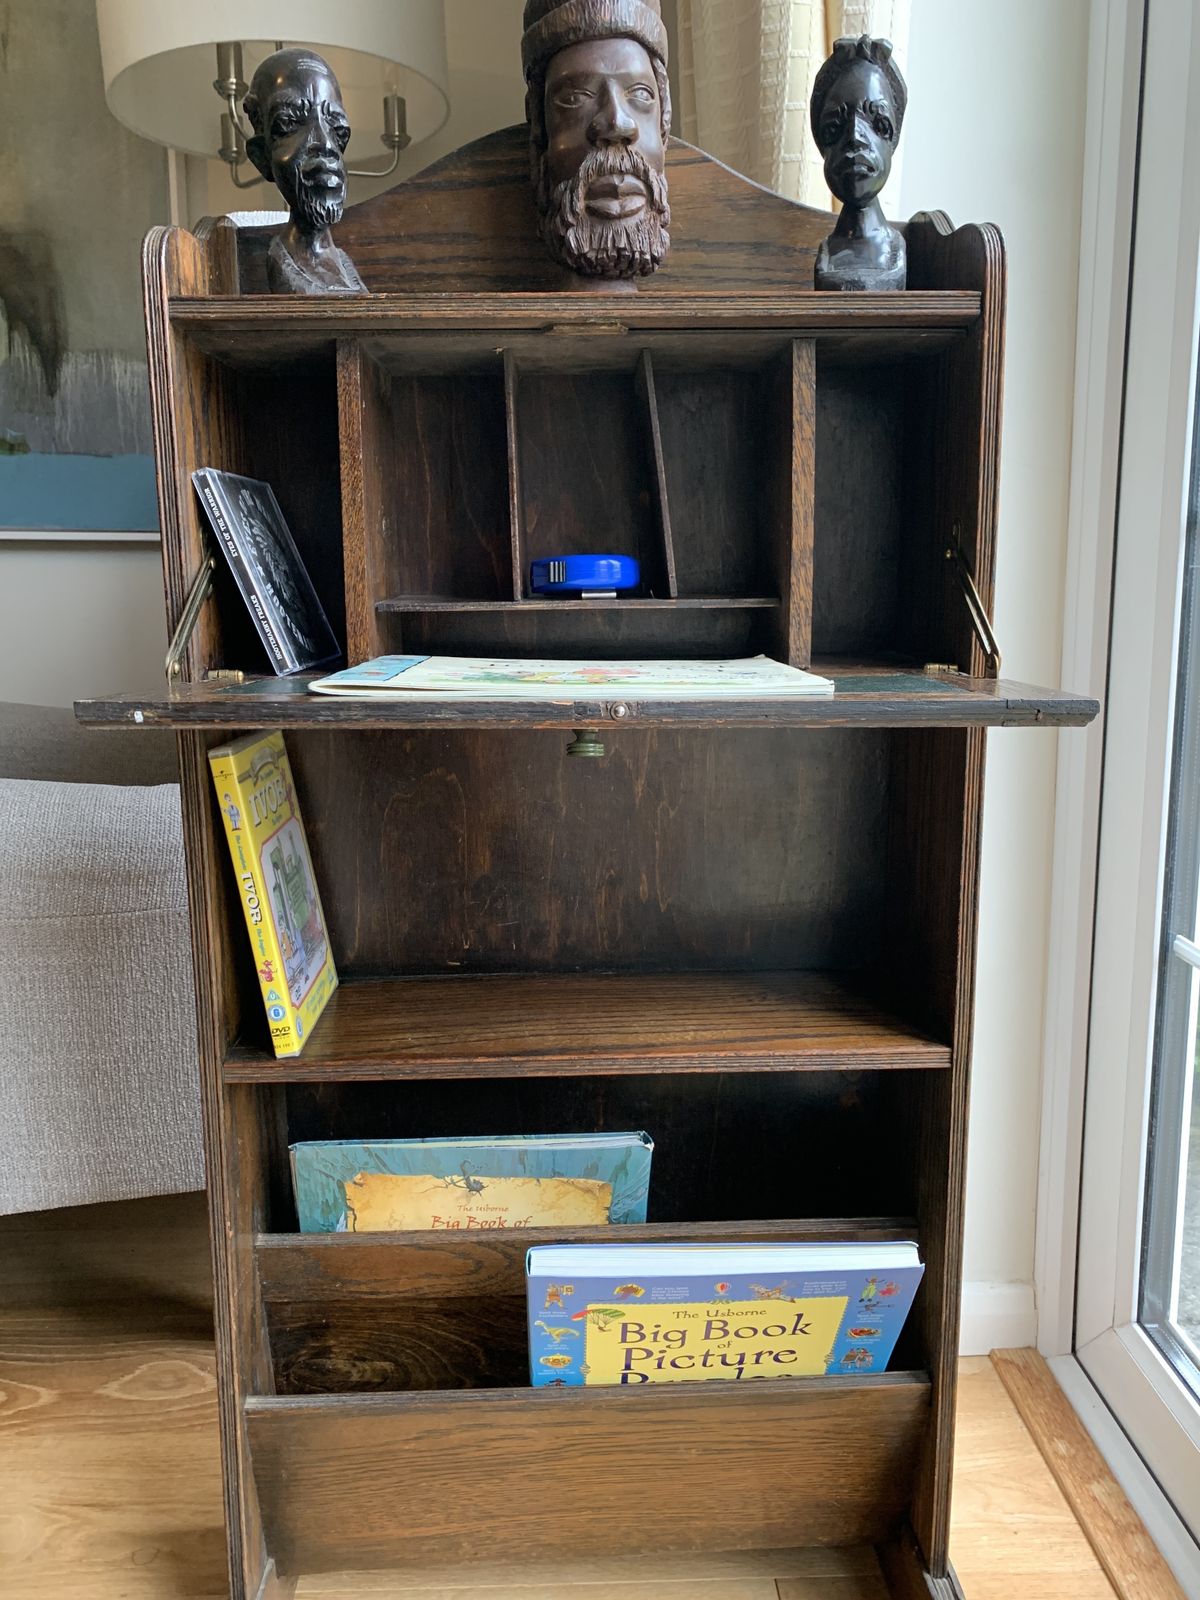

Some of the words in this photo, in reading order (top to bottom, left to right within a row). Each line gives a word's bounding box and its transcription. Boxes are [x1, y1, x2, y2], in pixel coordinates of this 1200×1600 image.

[204, 487, 220, 518] WARRIOR
[217, 518, 227, 532] THE
[223, 532, 231, 541] OF
[227, 541, 238, 557] EYES
[241, 871, 263, 926] IVOR
[271, 1026, 291, 1035] DVD
[458, 1204, 474, 1213] The
[476, 1203, 510, 1213] Usborne
[431, 1215, 461, 1230] Big
[466, 1215, 508, 1230] Book
[514, 1215, 534, 1229] of
[672, 1310, 699, 1319] The
[705, 1308, 768, 1319] Usborne
[617, 1321, 689, 1350] Big
[701, 1312, 814, 1342] Book
[717, 1340, 734, 1349] of
[620, 1346, 799, 1372] Picture
